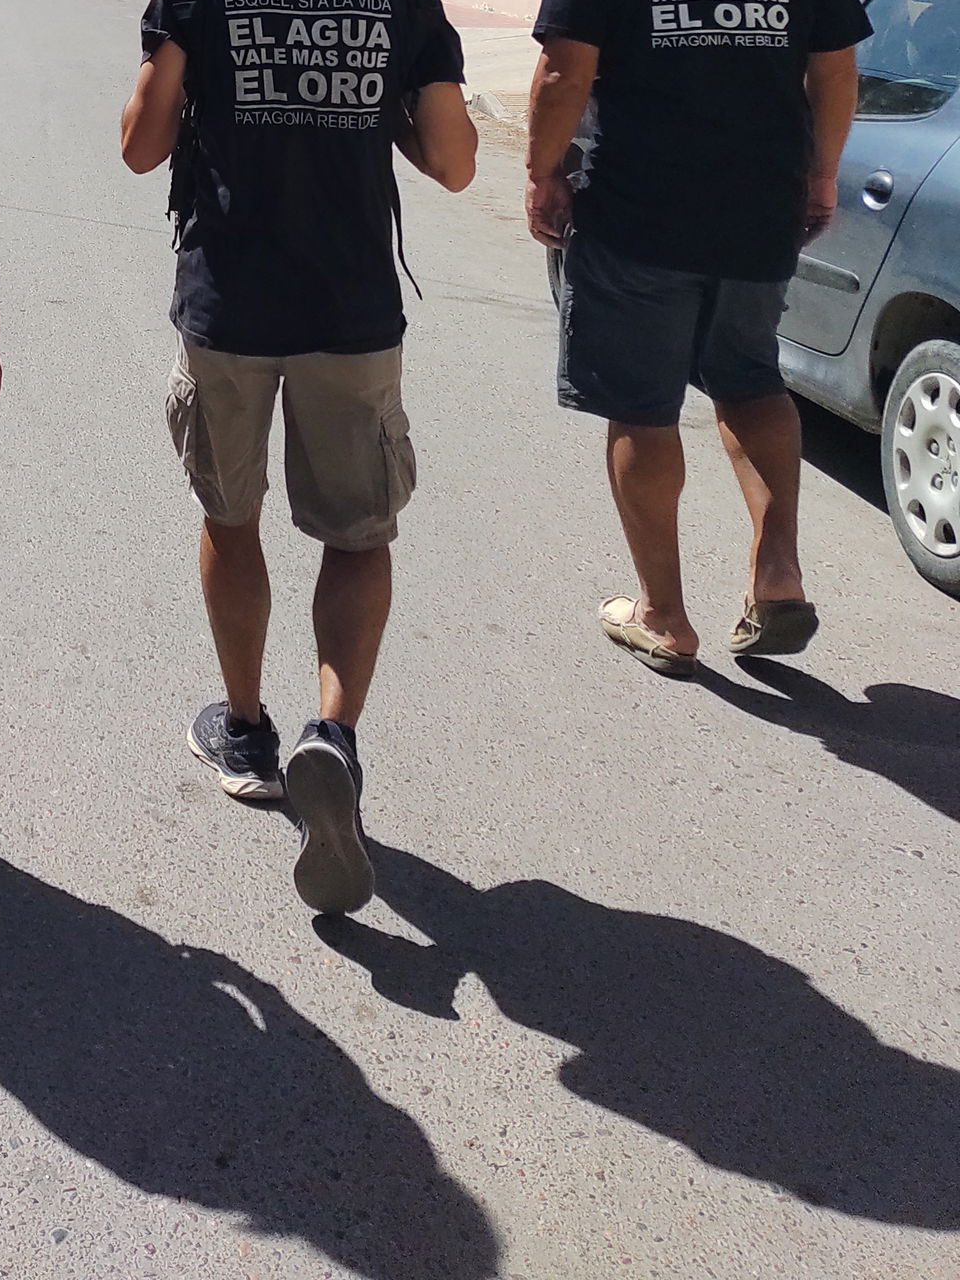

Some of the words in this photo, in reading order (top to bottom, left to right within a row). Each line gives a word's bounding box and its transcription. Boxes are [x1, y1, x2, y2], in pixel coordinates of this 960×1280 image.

[651, 4, 702, 30] EL
[714, 3, 789, 30] ORO
[228, 17, 275, 46] EL
[286, 19, 391, 49] AGUA
[652, 35, 732, 48] PATAGONIA
[735, 35, 789, 48] REBELDE
[230, 48, 287, 66] VALE
[292, 49, 339, 67] MAS
[346, 51, 389, 68] QUE
[235, 69, 288, 101] EL
[298, 70, 384, 105] ORO
[235, 111, 314, 125] PATAGONIA
